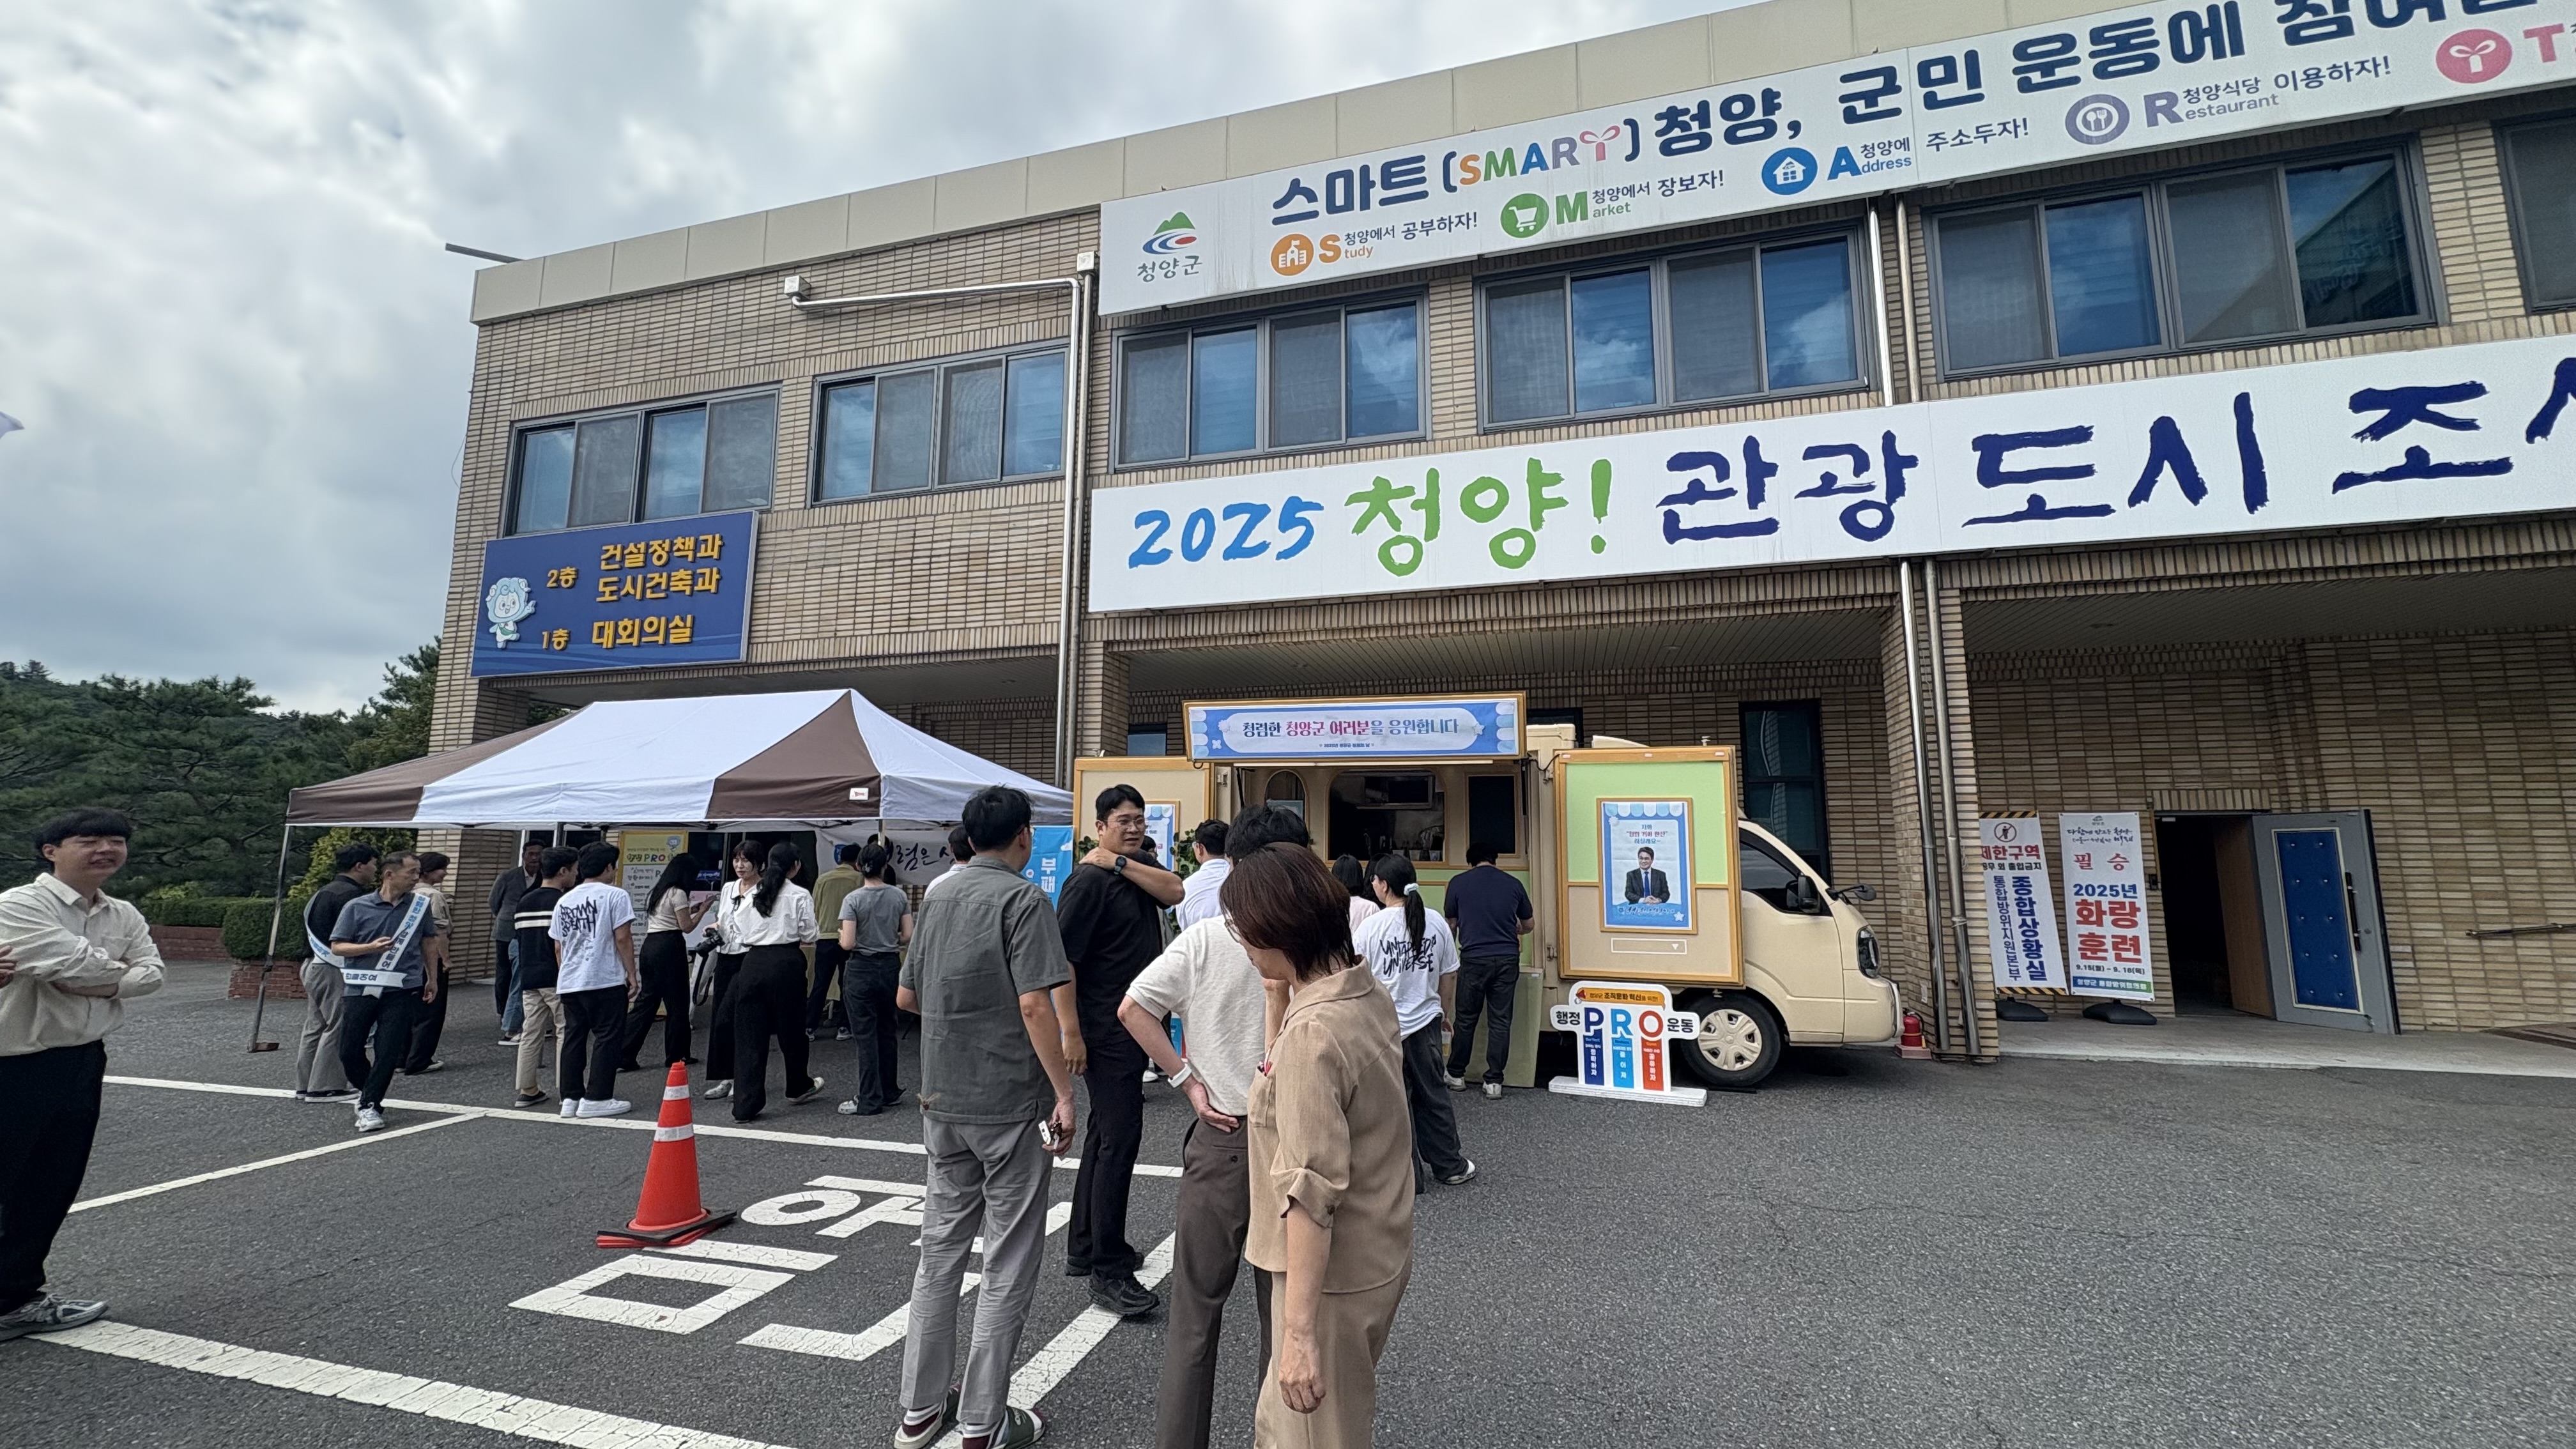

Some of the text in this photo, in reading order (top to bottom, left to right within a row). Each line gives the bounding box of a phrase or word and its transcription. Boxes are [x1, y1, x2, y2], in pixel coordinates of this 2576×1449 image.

[2182, 76, 2262, 105] 청양식당
[2273, 56, 2391, 92] 이용하자!
[1271, 155, 1430, 226] 스마트
[1655, 88, 1802, 157] 청양,
[1838, 49, 1986, 125] 군민
[2012, 1, 2246, 95] 운동에
[1860, 136, 1911, 159] 청양에
[1926, 117, 2030, 152] 주소두자!
[1592, 181, 1650, 204] 청양에서
[1657, 169, 1724, 198] 장보자!
[1344, 224, 1395, 246] 청양에서
[1401, 211, 1478, 241] 공부하자!
[1137, 256, 1202, 283] 청양군
[1128, 495, 1325, 569] 2025
[1345, 456, 1614, 578] 청양!
[1656, 430, 1919, 544] 관광
[1961, 392, 2269, 528] 도시
[600, 533, 723, 571] 건설정책과
[546, 565, 579, 588] 2층
[596, 567, 721, 602] 도시건축과
[542, 627, 571, 650] 1층
[592, 613, 694, 650] 대회의실
[1242, 717, 1459, 738] 청렴한 청양군 여러분을 응원합니다
[1981, 845, 2041, 861] 제한구역
[2008, 862, 2042, 871] 출입금지
[2073, 883, 2138, 899] 2025년
[1993, 875, 2021, 981] 통합방위지원본부
[2012, 876, 2048, 981] 종합상황실
[2075, 899, 2142, 930] 화랑
[2078, 932, 2142, 963] 훈련
[1383, 953, 1434, 977] UNIVERSE
[1556, 1007, 1694, 1038] 행정 PRO 운동
